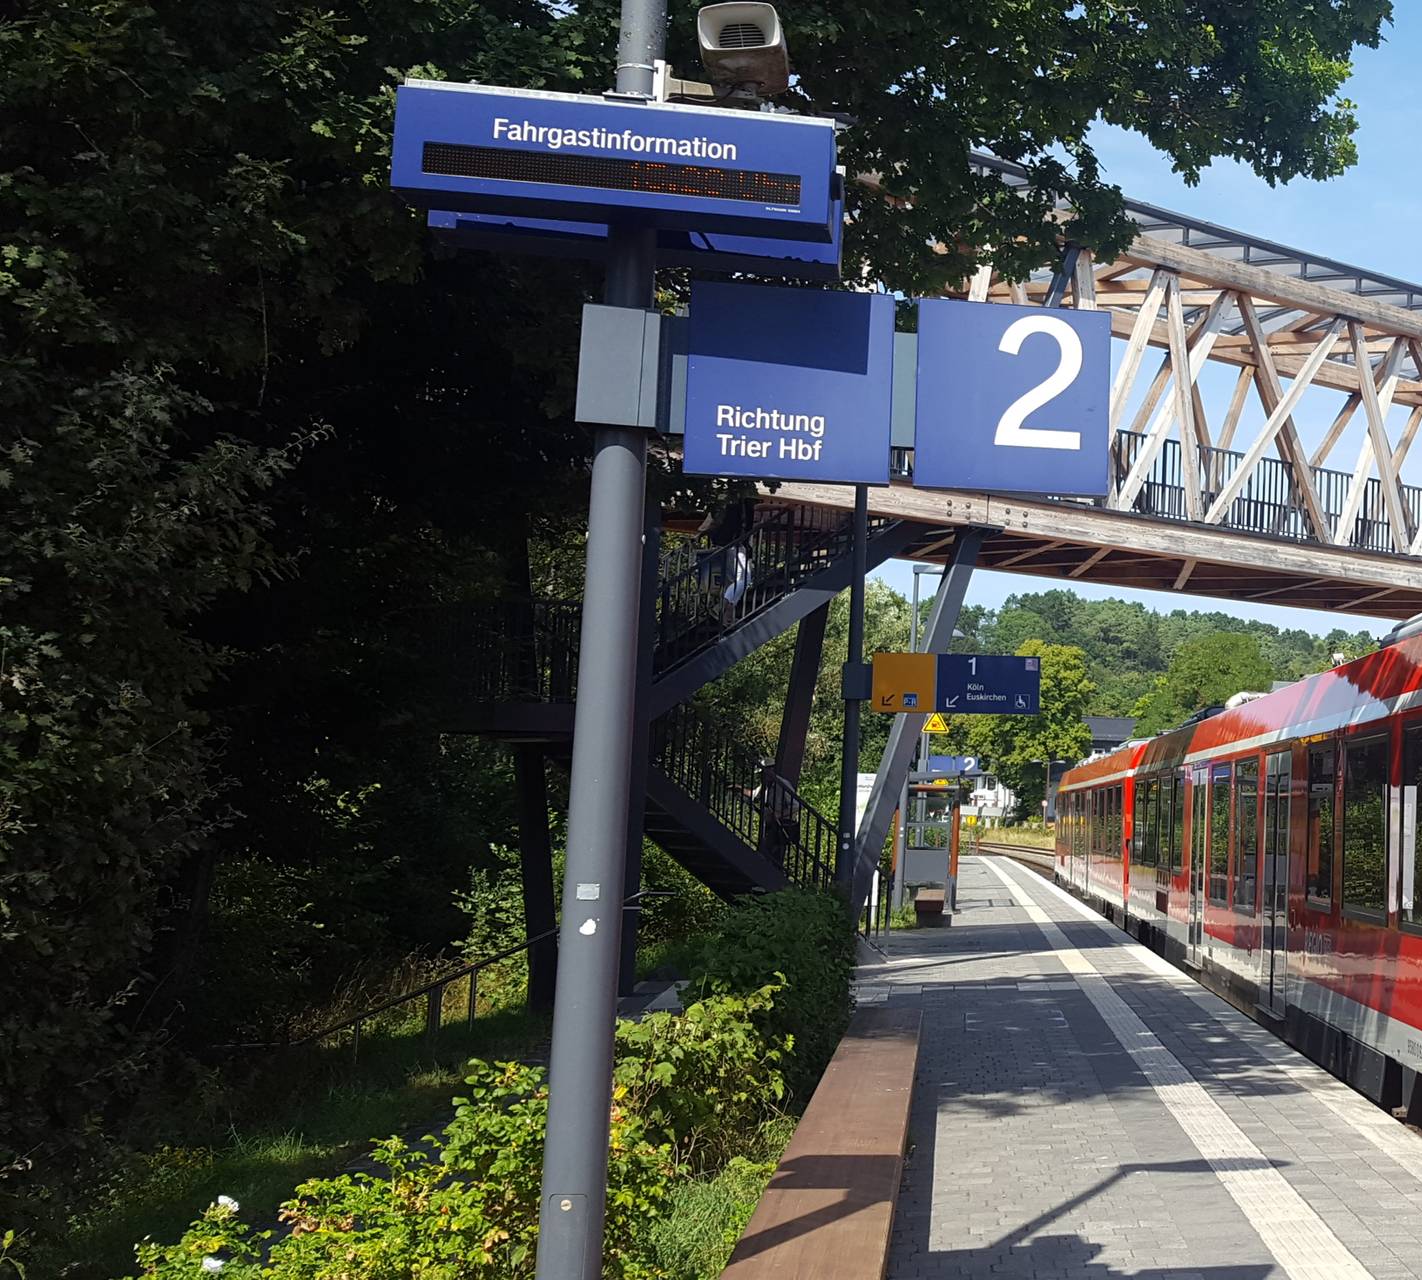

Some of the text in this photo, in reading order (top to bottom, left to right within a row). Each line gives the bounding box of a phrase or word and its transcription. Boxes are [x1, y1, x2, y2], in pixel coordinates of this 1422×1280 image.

[492, 117, 737, 161] Fahrgastinformation
[993, 315, 1084, 450] 2
[716, 404, 825, 437] Richtung
[716, 433, 823, 462] Trier Hbf
[968, 657, 976, 676] 1
[966, 692, 1007, 701] Euskirchen
[967, 682, 984, 691] Köln
[964, 756, 976, 771] 2
